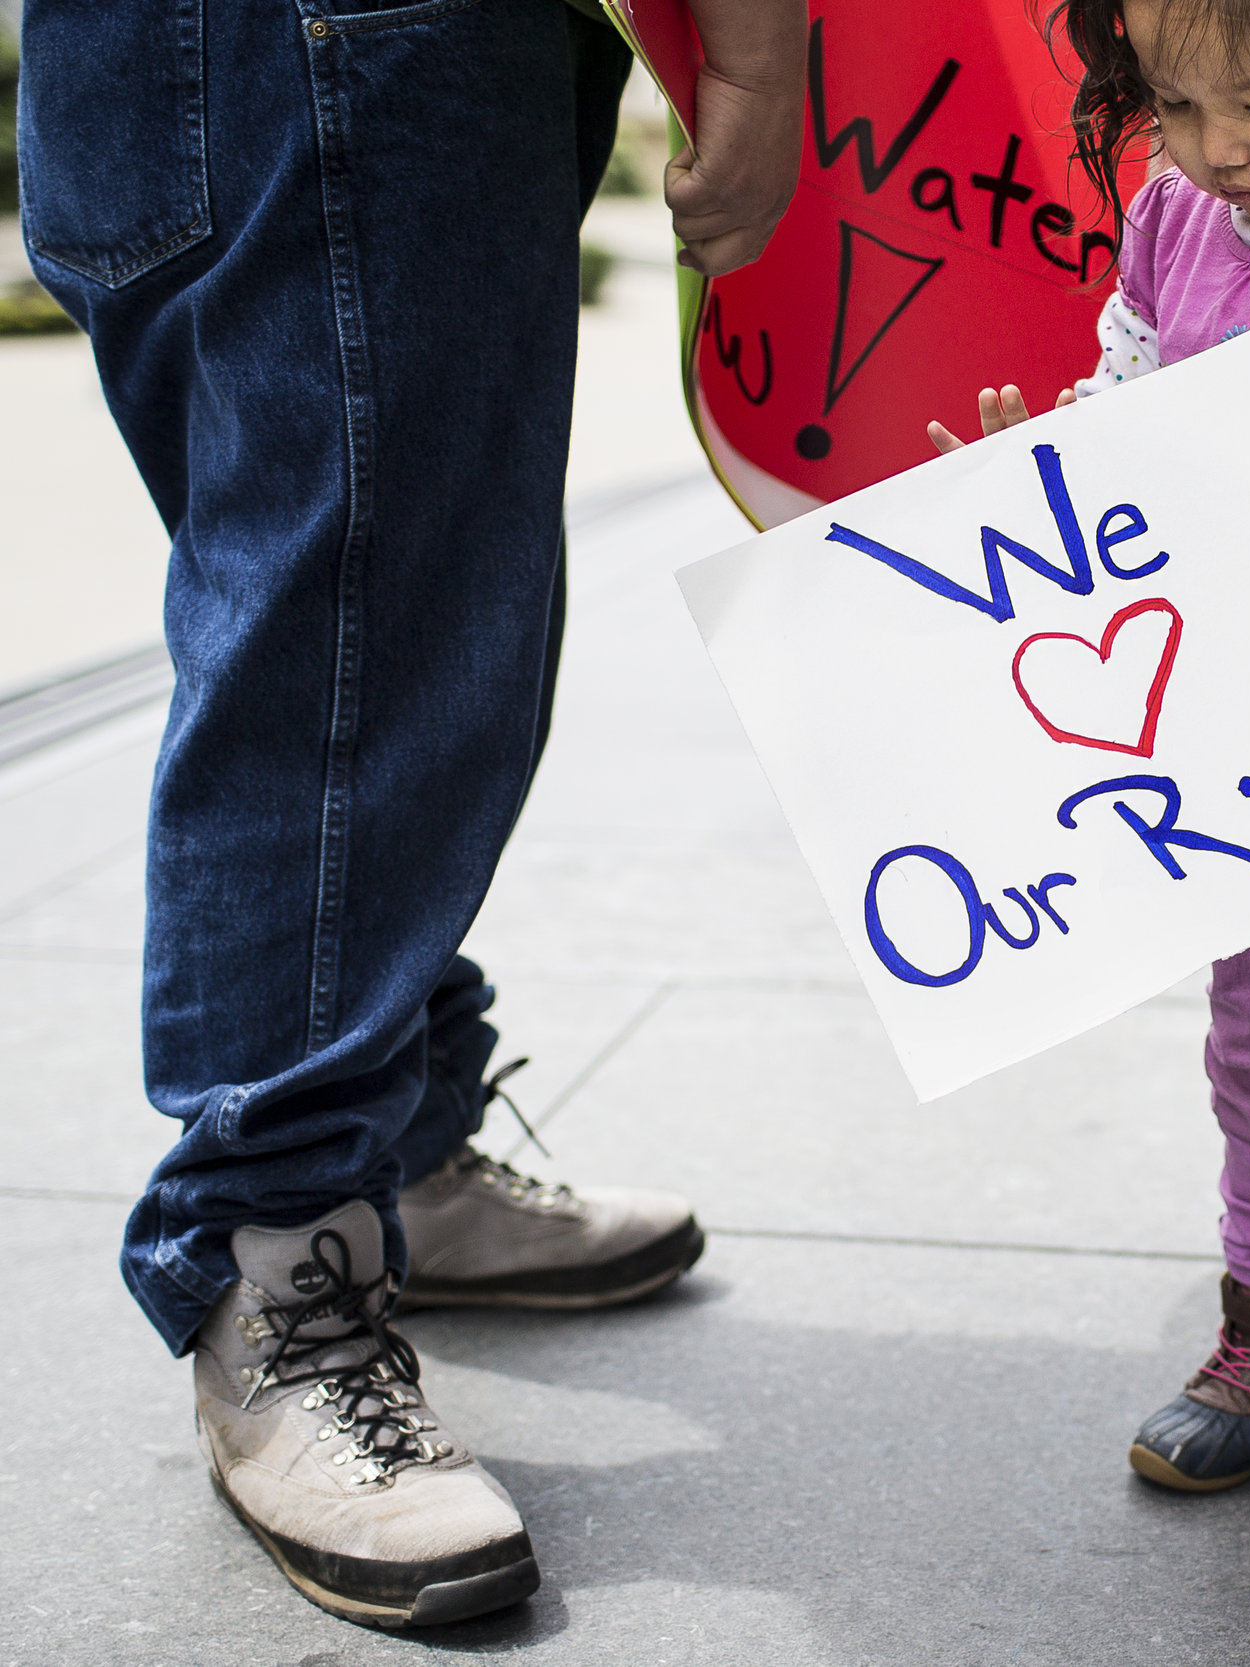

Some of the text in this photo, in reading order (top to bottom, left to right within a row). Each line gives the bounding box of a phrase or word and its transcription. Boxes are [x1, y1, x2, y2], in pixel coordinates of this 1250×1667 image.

[806, 16, 1116, 284] Water
[825, 444, 1170, 624] We
[864, 844, 1077, 988] Our
